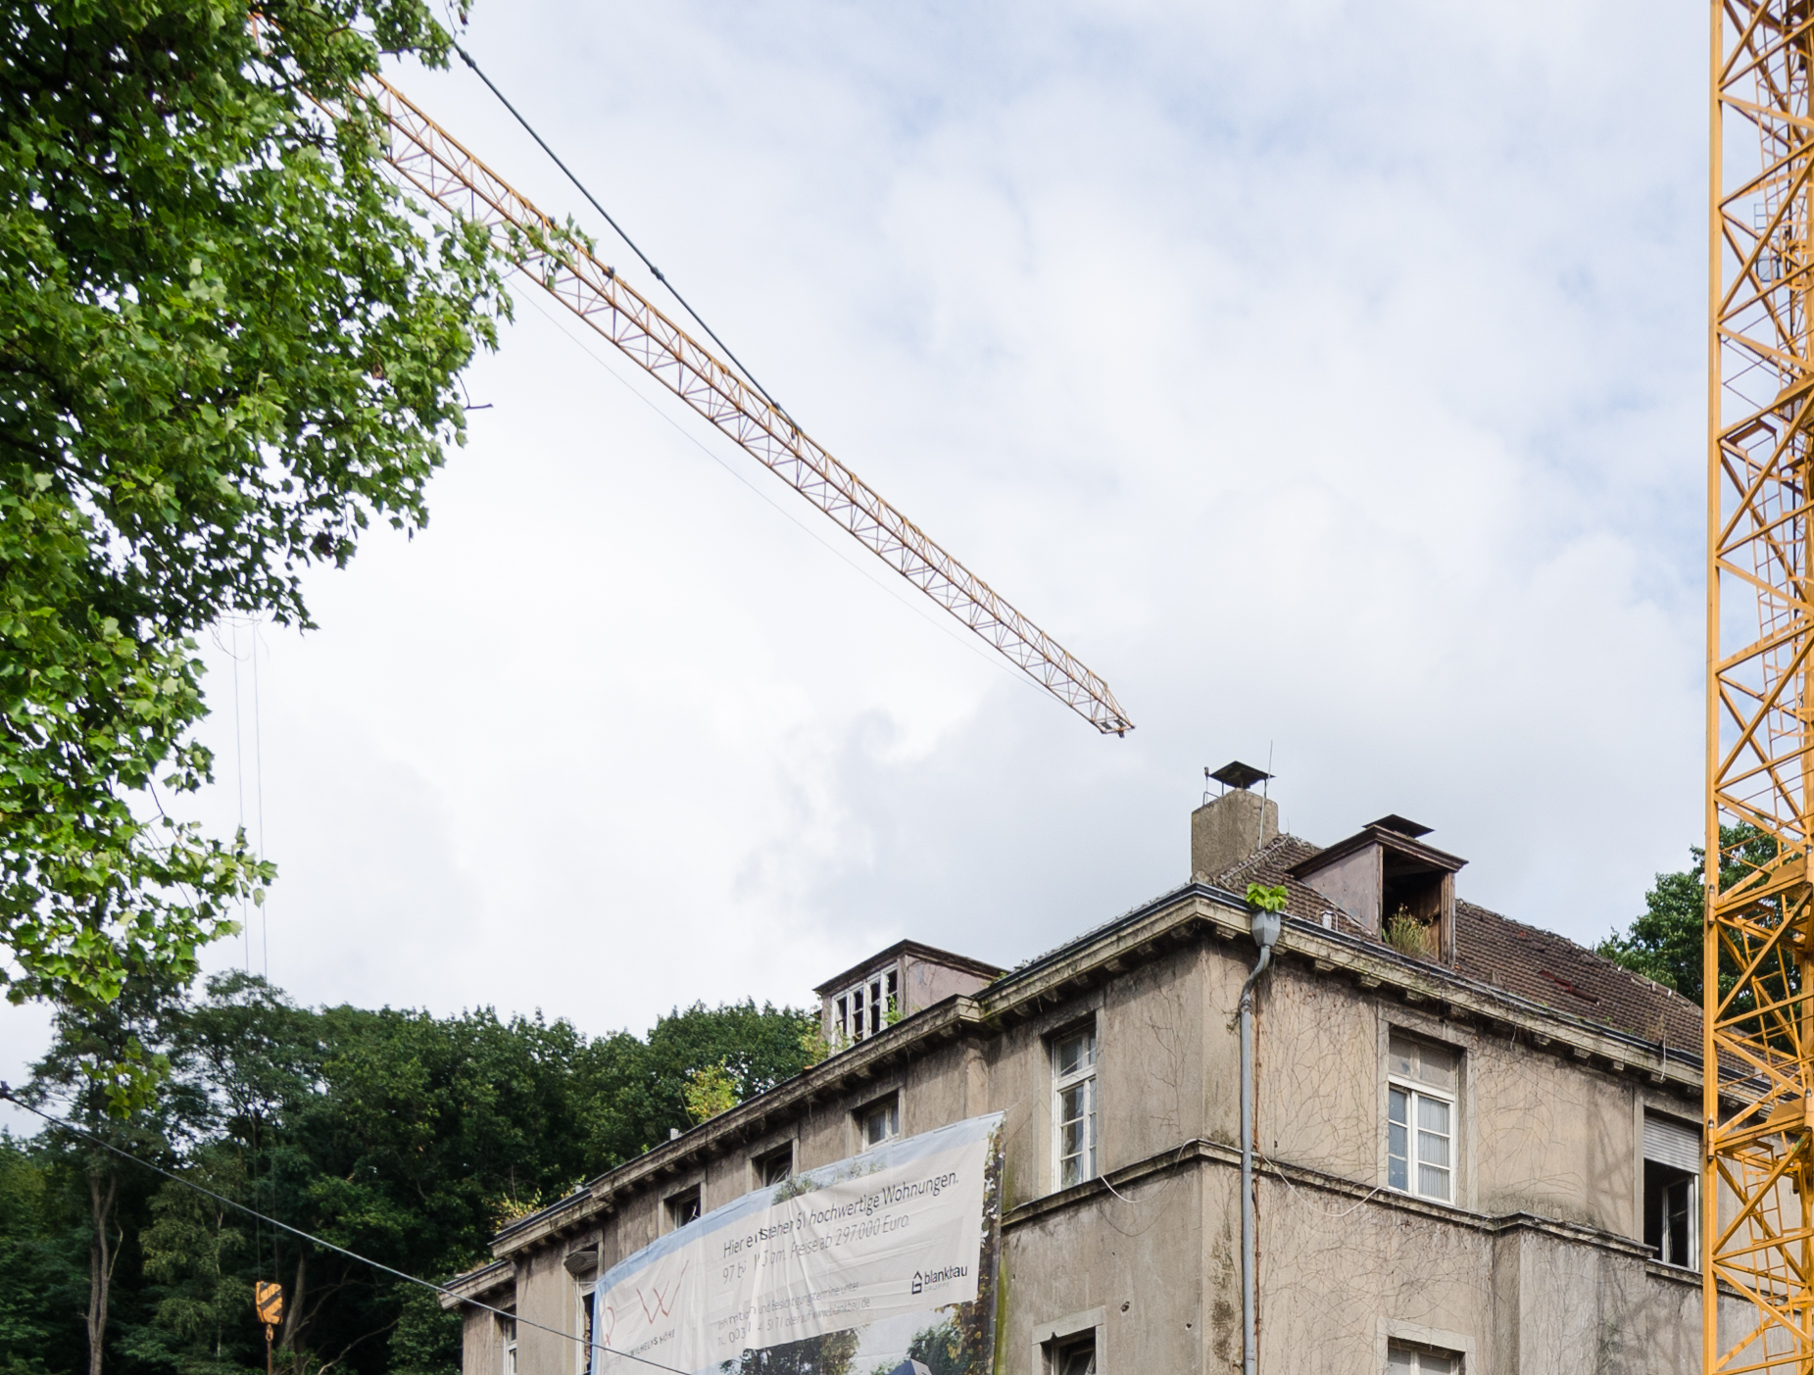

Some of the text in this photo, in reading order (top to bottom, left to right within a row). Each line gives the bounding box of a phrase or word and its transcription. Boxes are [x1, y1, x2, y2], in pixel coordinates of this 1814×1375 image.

[723, 1240, 744, 1258] Hier
[809, 1195, 880, 1226] hochwertige
[882, 1172, 959, 1205] Wohnungen.
